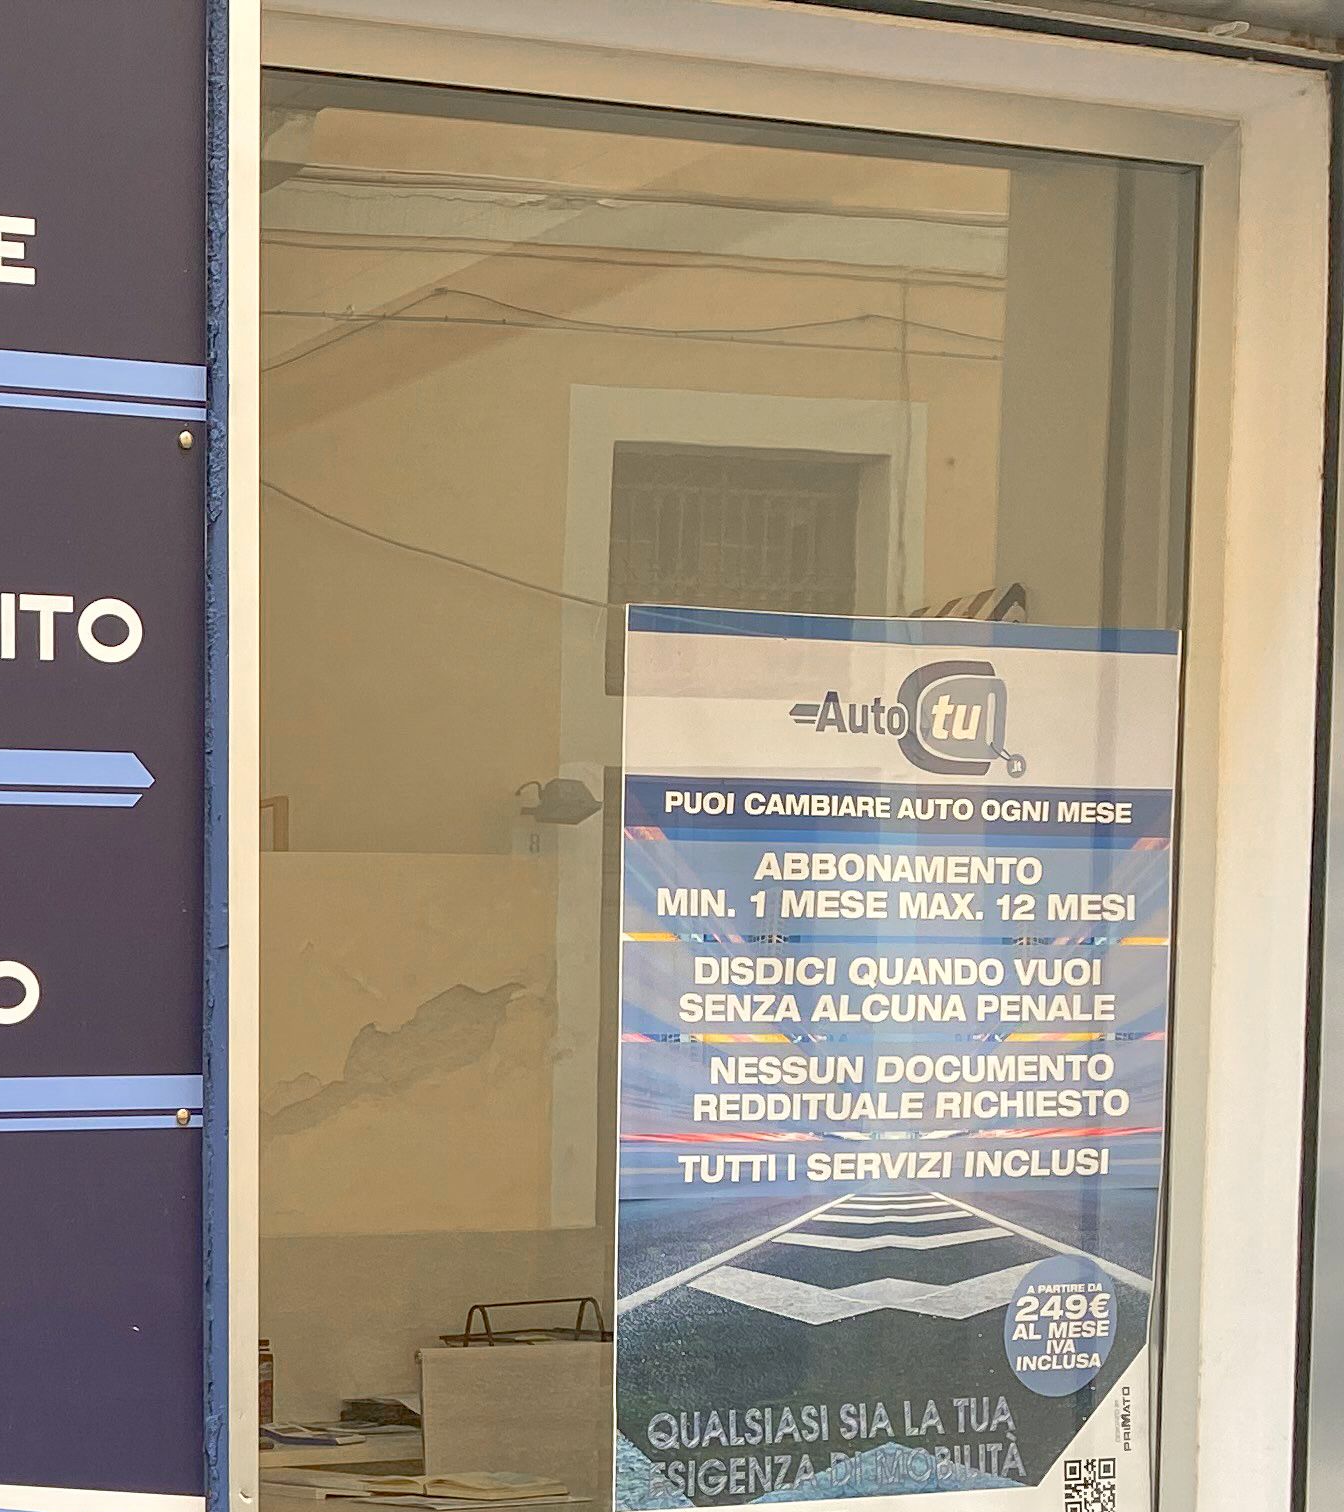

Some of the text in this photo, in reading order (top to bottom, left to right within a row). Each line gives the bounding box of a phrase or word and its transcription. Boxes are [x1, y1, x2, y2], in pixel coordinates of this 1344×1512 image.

[816, 691, 906, 735] Auto
[931, 695, 981, 740] tu
[665, 791, 1132, 824] PUOI CAMBIARE AUTO OGNI MESE
[754, 852, 1042, 886] ABBONAMENTO
[656, 889, 1135, 921] MIN. 1 MESE MAX. 12 MESI
[694, 957, 1102, 986] DISDICI QUANDO VUOI
[679, 994, 1116, 1023] SENZA ALCUNA PENALE
[710, 1054, 1115, 1085] NESSUN DOCUMENTO
[693, 1089, 1130, 1122] REDDITUALE RICHIESTO
[679, 1148, 1109, 1183] TUTTI I SERVIZI INCLUSI
[1027, 1283, 1102, 1293] A PARTIRE DA
[1014, 1293, 1111, 1322] 249€
[1012, 1320, 1110, 1341] AL MESE
[1016, 1353, 1102, 1371] INCLUSA
[1046, 1340, 1075, 1354] IVA
[648, 1396, 1016, 1450] QUALSIASI SIA LA TUA
[1121, 1386, 1131, 1452] PRIMATO
